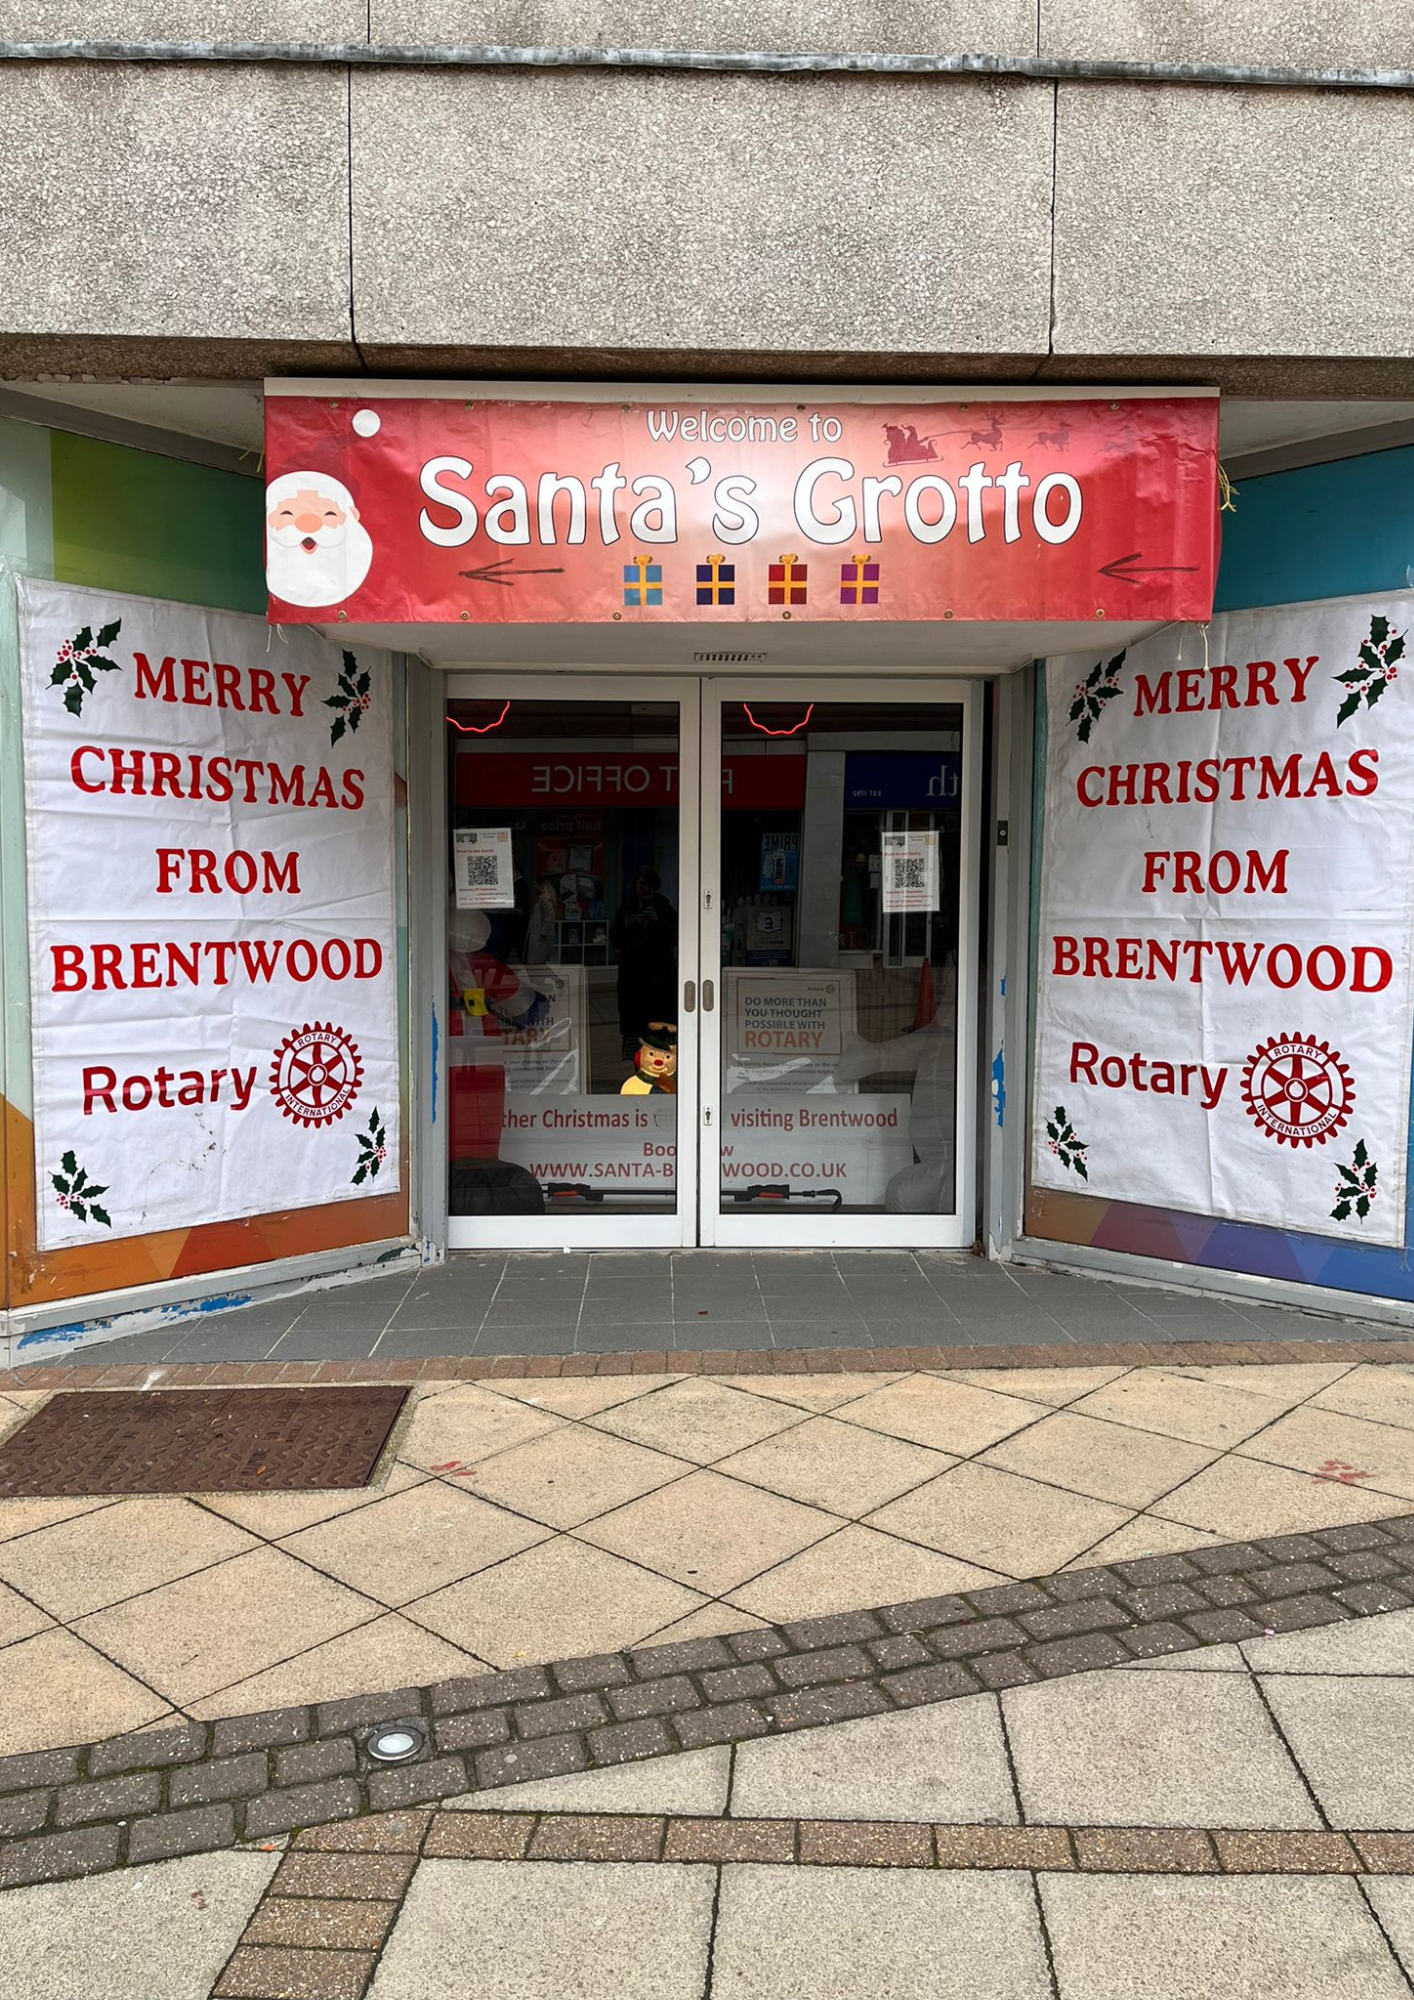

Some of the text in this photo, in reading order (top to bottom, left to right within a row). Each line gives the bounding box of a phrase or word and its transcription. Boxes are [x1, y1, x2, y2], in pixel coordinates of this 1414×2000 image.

[647, 409, 843, 443] Welcome to
[417, 455, 1084, 549] Santa's Grotto
[133, 652, 311, 718] MERRY
[1133, 655, 1319, 717] MERRY
[70, 745, 365, 811] CHRISTMAS
[1076, 748, 1379, 808] CHRISTMAS
[156, 847, 301, 895] FROM
[1141, 848, 1289, 894] FROM
[50, 937, 383, 993] BRENTWOOD
[1051, 935, 1393, 994] BRENTWOOD
[745, 997, 827, 1007] DO MORE THAN
[745, 1008, 823, 1018] YOU THOUGHT
[298, 1032, 338, 1047] ROTARY
[745, 1020, 826, 1030] POSSIBLE WITH
[745, 1031, 824, 1048] ROTARY
[1273, 1044, 1323, 1060] ROTARY
[81, 1062, 258, 1116] Rotary
[1069, 1040, 1228, 1111] Rotary
[285, 1089, 350, 1117] INTERNATIONAL
[542, 1109, 630, 1128] Christmas
[635, 1109, 648, 1128] is
[730, 1108, 898, 1132] visiting Brentwood
[1257, 1104, 1337, 1136] INTERNATIONAL
[643, 1142, 677, 1157] Boo
[531, 1162, 847, 1178] WWW.SANTA-BWOOD.CO.UK
